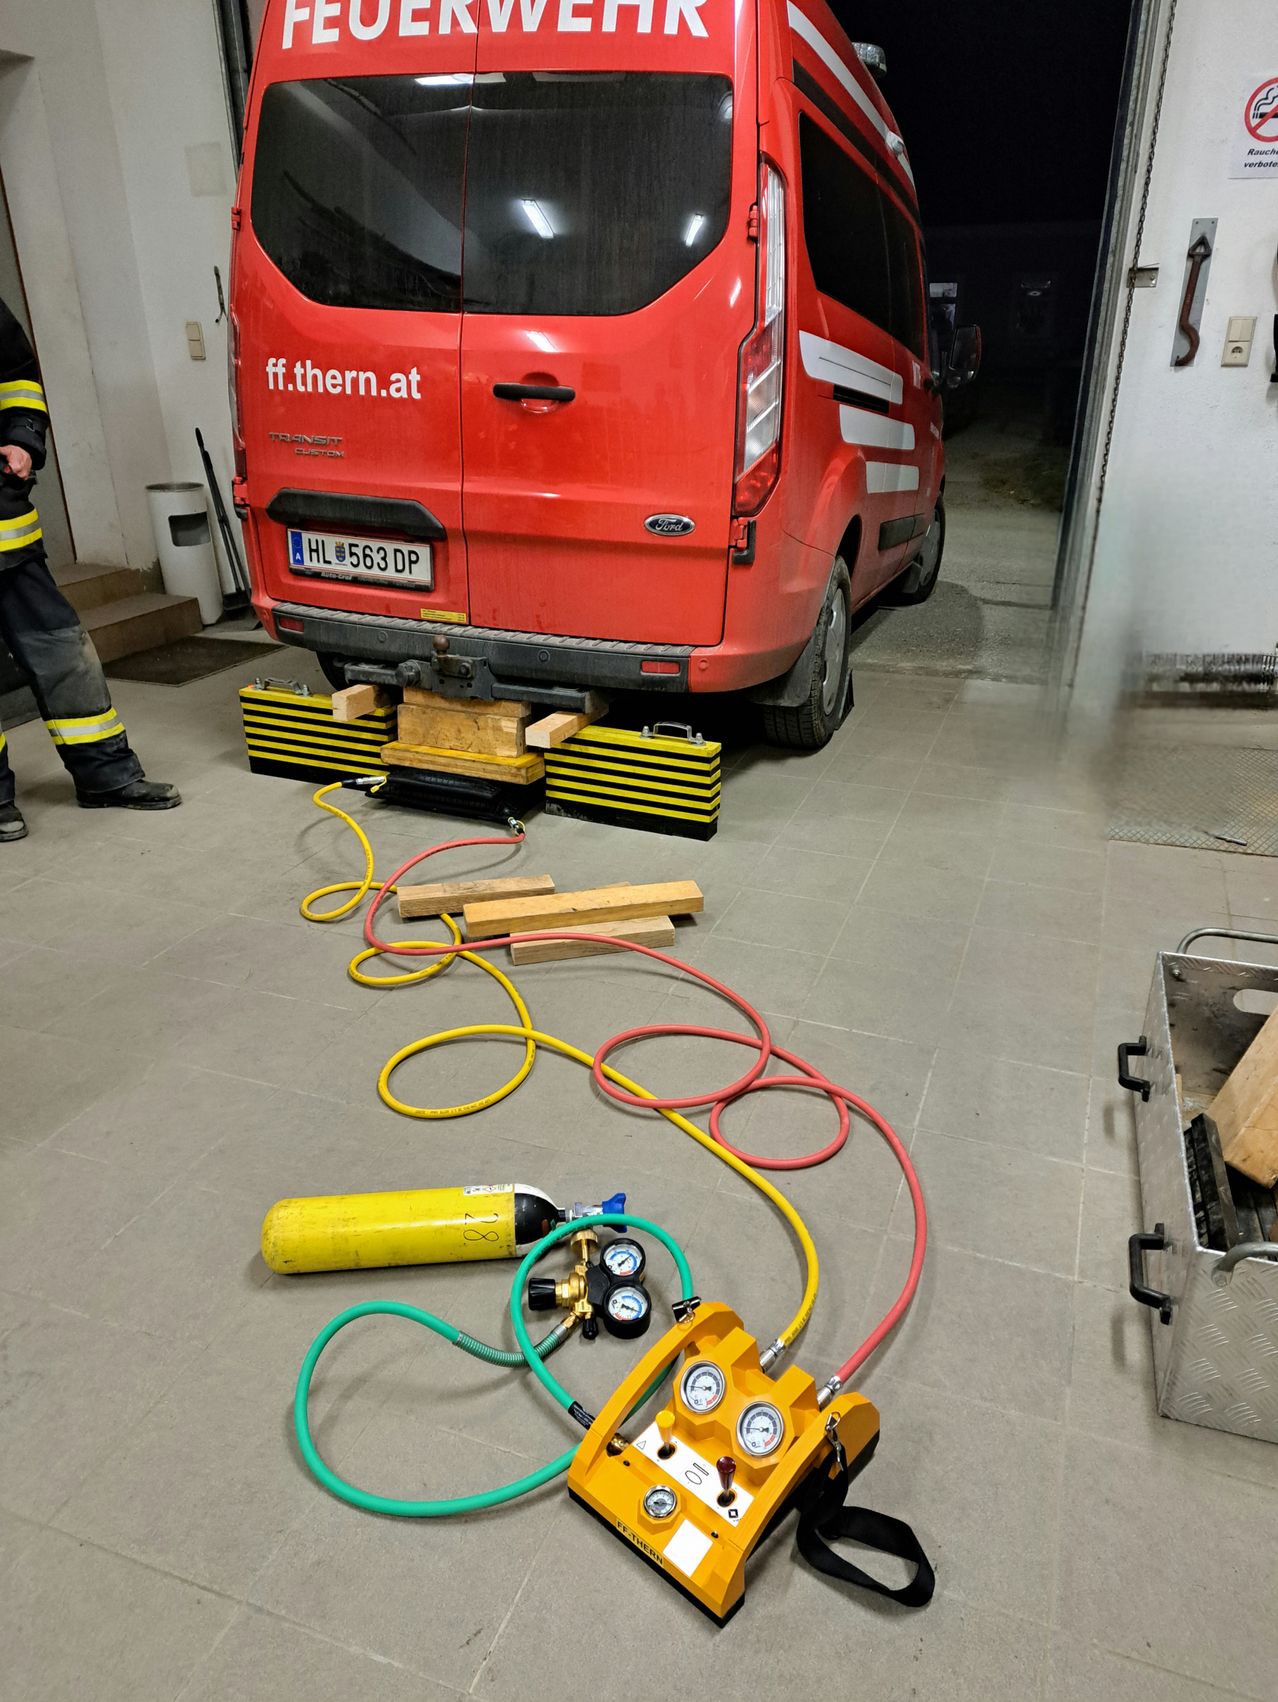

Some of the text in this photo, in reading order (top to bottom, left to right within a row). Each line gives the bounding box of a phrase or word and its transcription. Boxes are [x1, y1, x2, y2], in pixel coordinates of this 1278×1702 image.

[266, 357, 422, 400] ff.thern.at
[268, 431, 343, 446] TRANSIT
[295, 447, 344, 458] CUSTOM
[655, 518, 684, 531] Ford
[295, 552, 302, 561] A
[307, 538, 420, 575] HL 563 DP
[616, 1520, 664, 1566] FF-THERN
